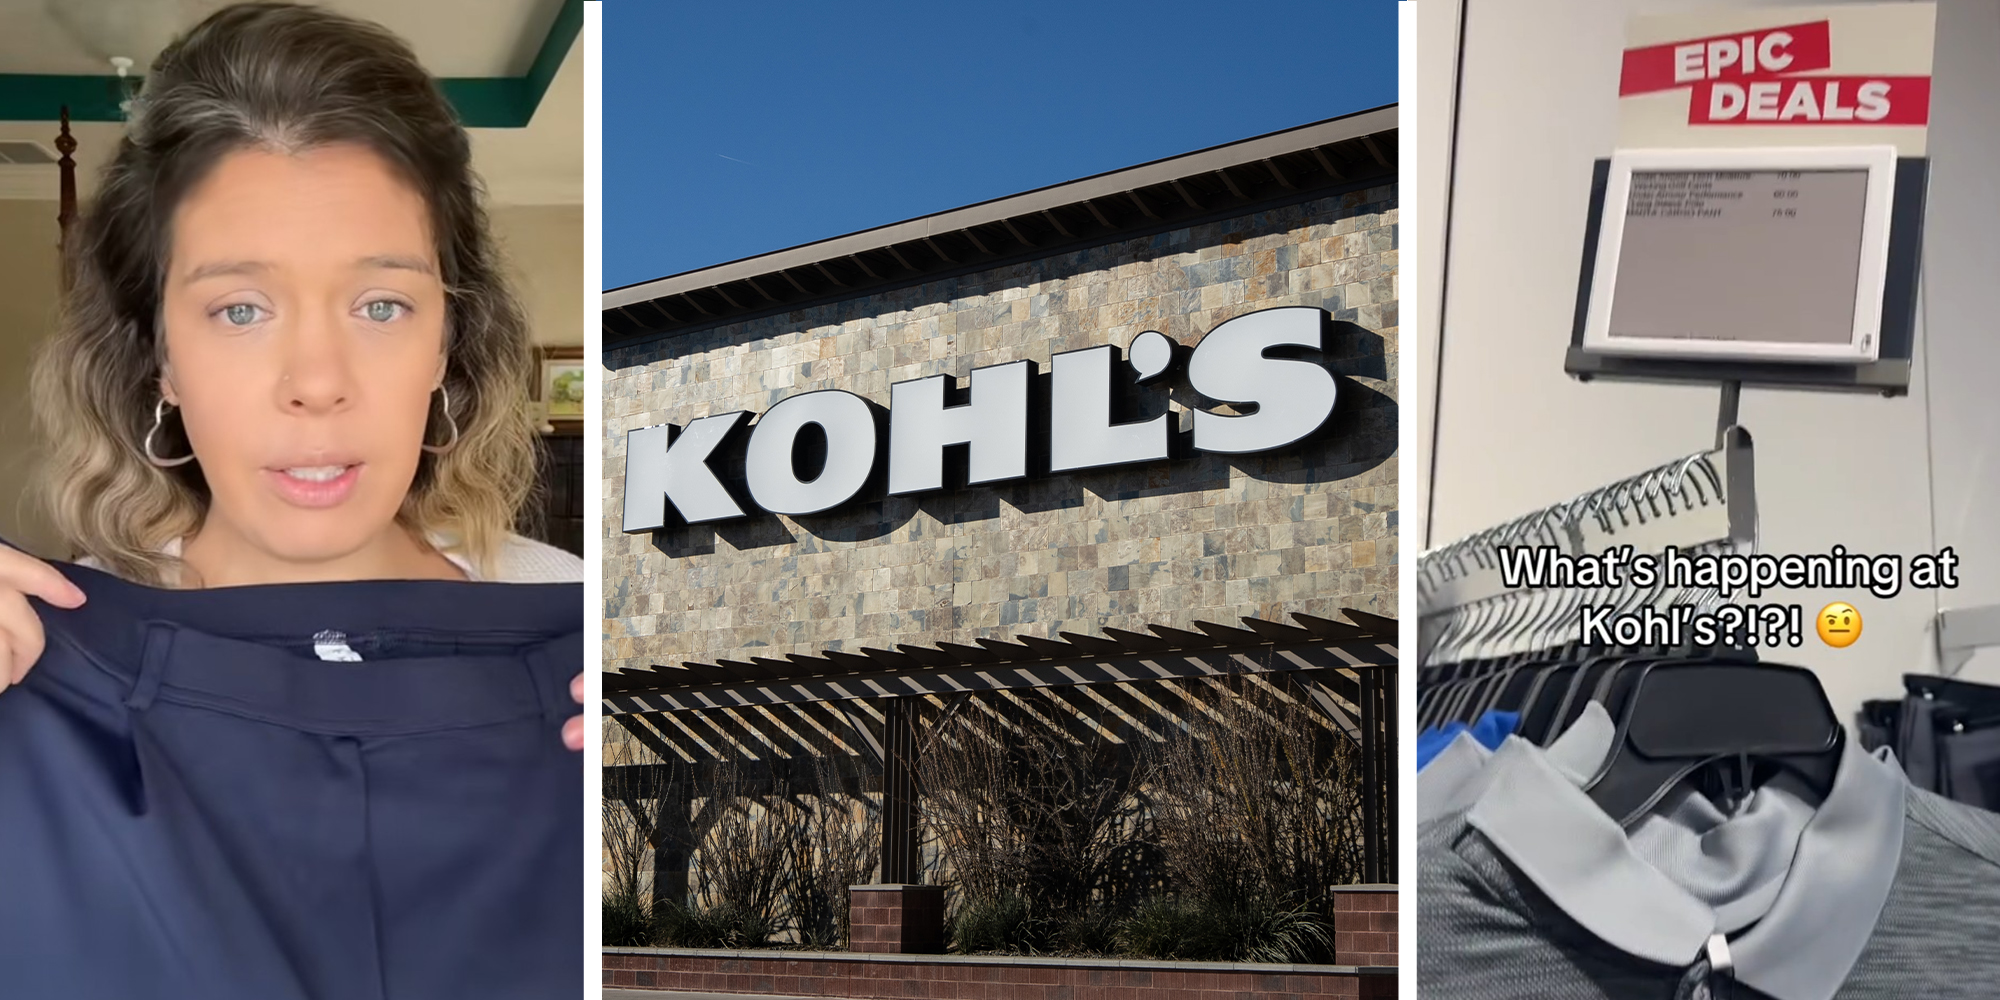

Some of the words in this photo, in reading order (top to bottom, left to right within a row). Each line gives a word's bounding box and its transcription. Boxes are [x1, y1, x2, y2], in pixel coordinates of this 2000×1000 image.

[1674, 32, 1794, 84] EPIC
[1708, 81, 1892, 121] DEALS
[622, 305, 1340, 534] KOHL'S
